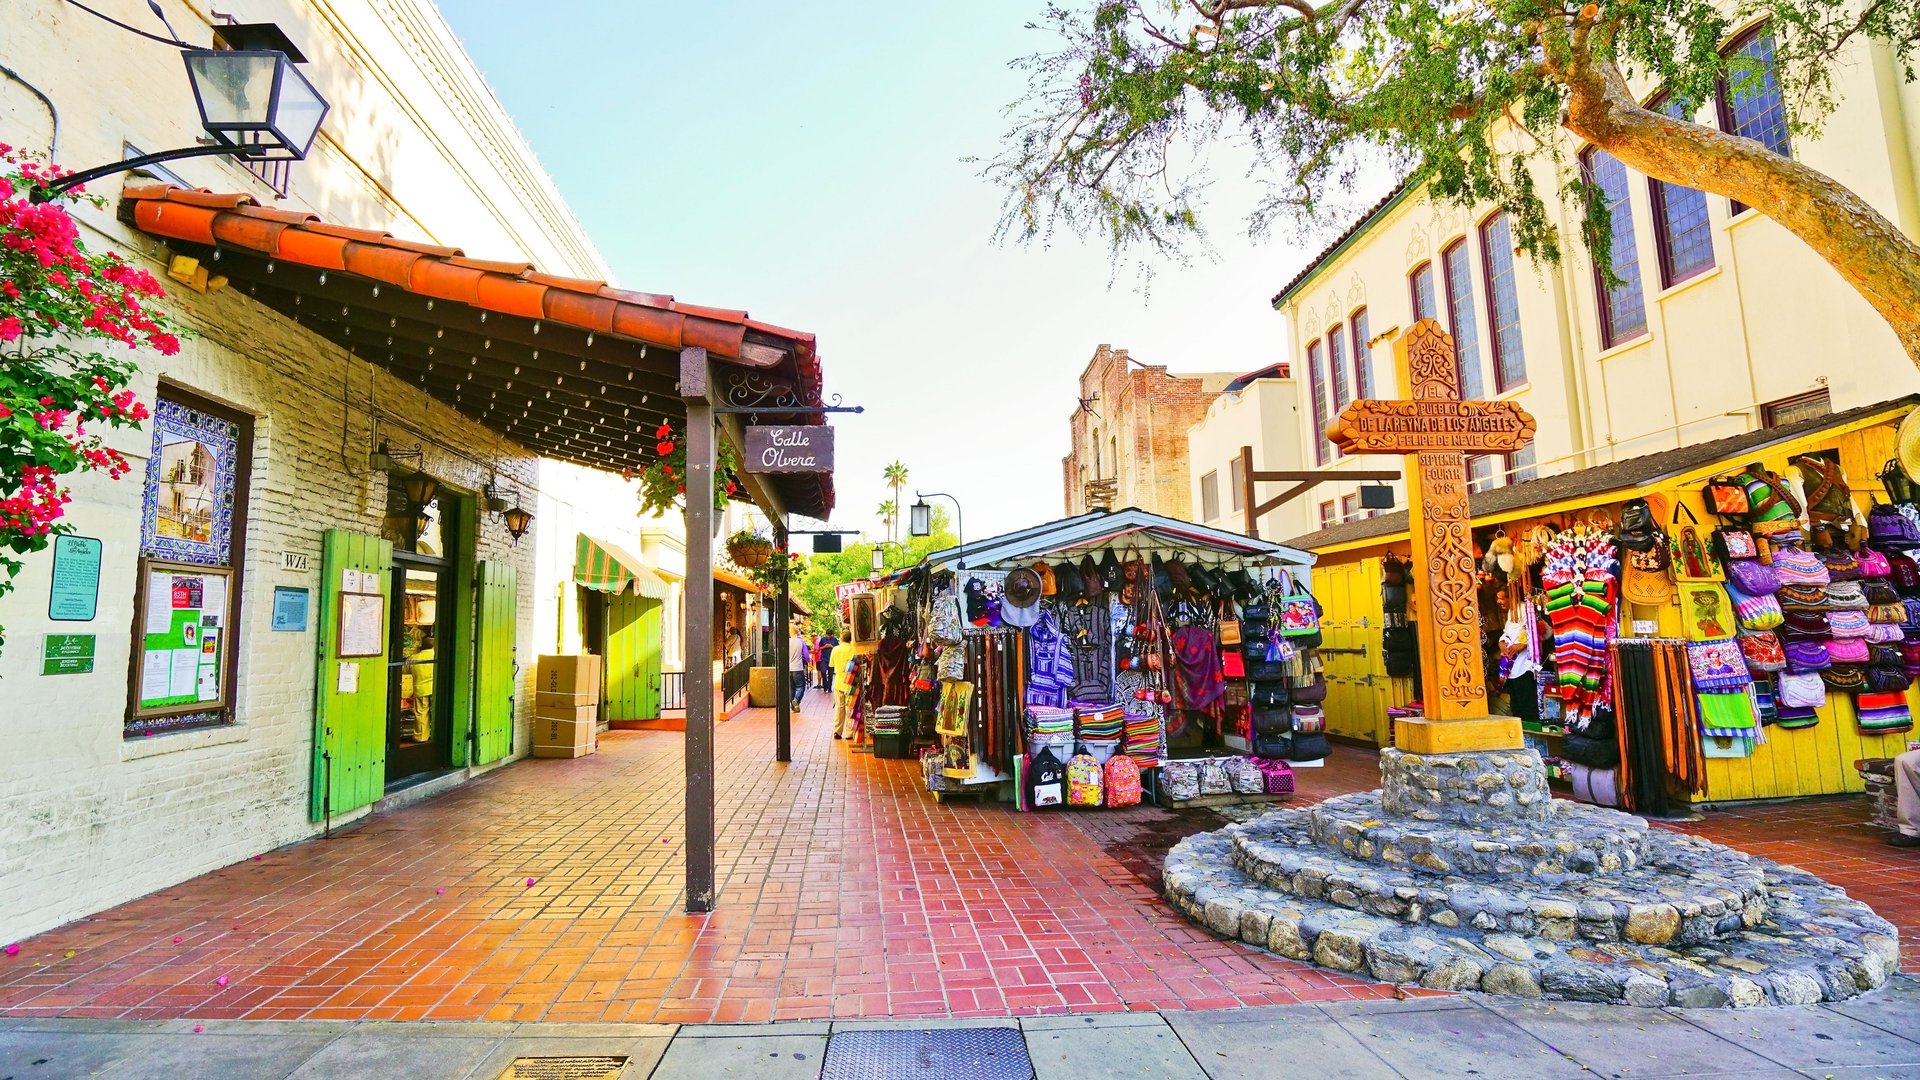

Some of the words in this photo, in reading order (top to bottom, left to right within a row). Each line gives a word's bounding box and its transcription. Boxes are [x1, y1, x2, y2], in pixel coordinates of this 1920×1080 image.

[1428, 386, 1443, 398] EL
[1419, 403, 1457, 414] PUEBLO
[1359, 417, 1377, 432] DE
[1377, 417, 1393, 432] LA
[1393, 417, 1428, 432] REYNA
[1429, 417, 1444, 432] DE
[1445, 417, 1467, 432] LOS
[1468, 417, 1516, 432] ANGELES
[770, 429, 810, 447] Calle
[1397, 434, 1435, 446] FELIPE
[1436, 434, 1450, 446] DE
[1451, 434, 1483, 446] NEVE
[762, 447, 816, 467] Olvera
[1420, 454, 1463, 466] SEPTEMBER
[1425, 469, 1461, 480] FOURTH
[1433, 483, 1456, 495] 1781
[839, 582, 867, 600] ATM
